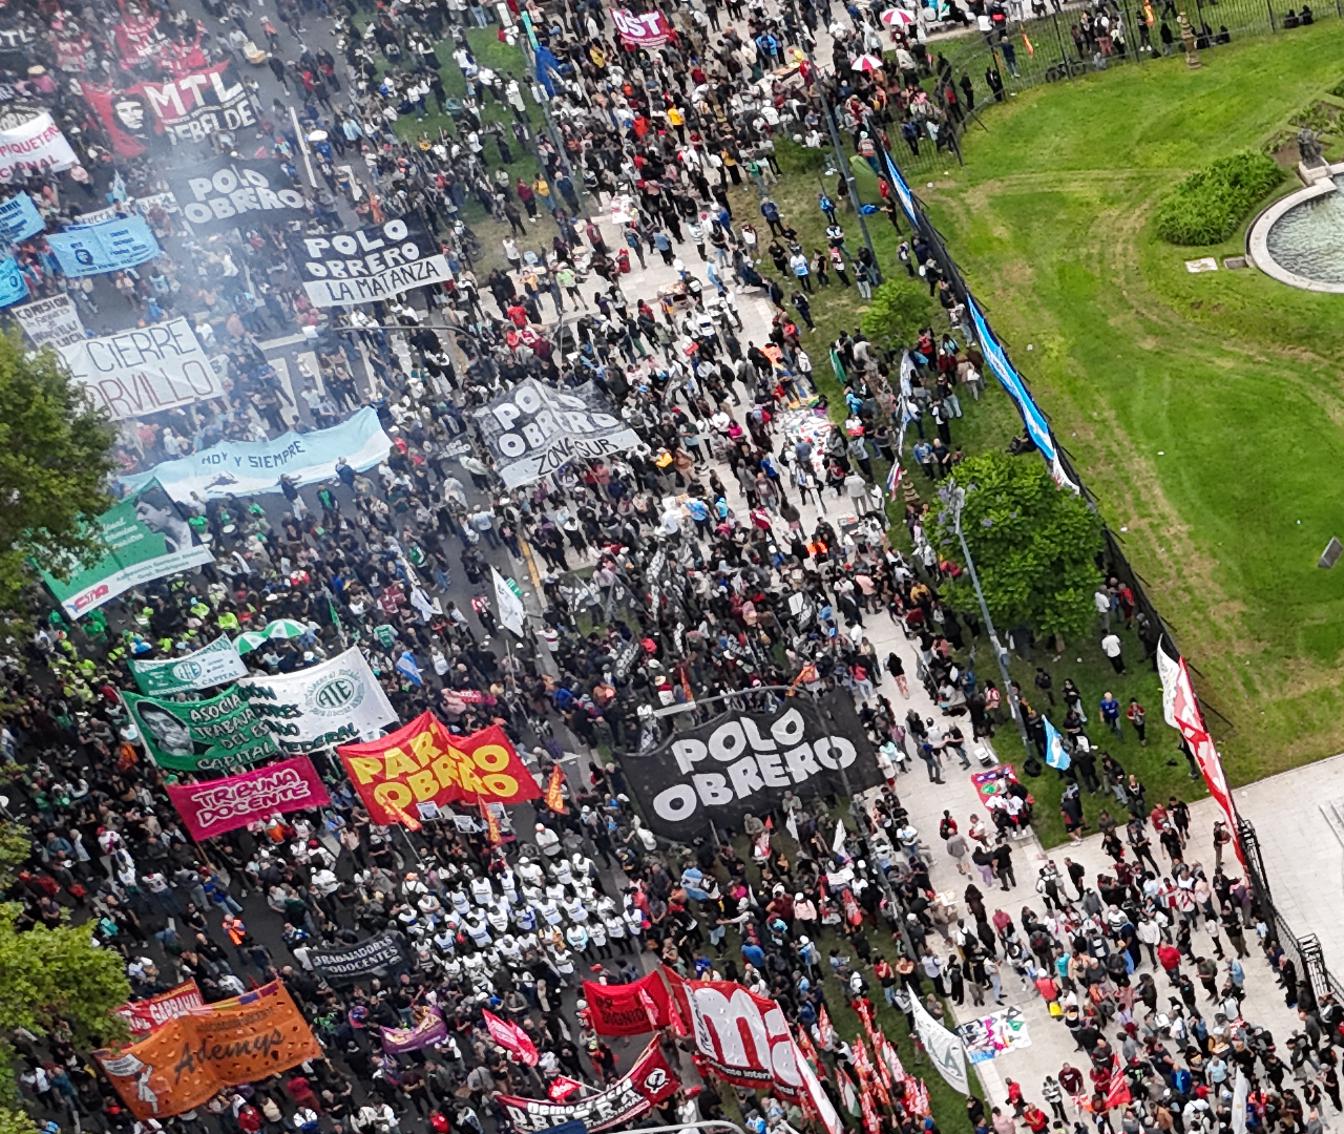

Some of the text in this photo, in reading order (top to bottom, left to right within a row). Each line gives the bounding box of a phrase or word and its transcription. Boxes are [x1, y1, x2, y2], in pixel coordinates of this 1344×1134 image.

[144, 72, 244, 118] MTL
[188, 164, 269, 201] POLO
[184, 187, 304, 224] OBRERO
[303, 218, 408, 258] POLO
[305, 242, 419, 279] OBRERO
[325, 261, 440, 301] LA MATANZA
[86, 318, 196, 373] CIERRE
[201, 440, 305, 468] HOY Y SIEMPRE
[574, 438, 618, 457] SUR
[202, 671, 239, 686] CAPITAL
[317, 677, 354, 711] ATE
[197, 742, 273, 772] CAPITAL
[222, 735, 250, 750] DEL
[671, 707, 805, 775] POLO
[192, 768, 299, 808] TRIBUNA
[653, 735, 858, 822] OBRERO
[196, 780, 310, 828] DOCENTE
[527, 1079, 633, 1116] Democracia
